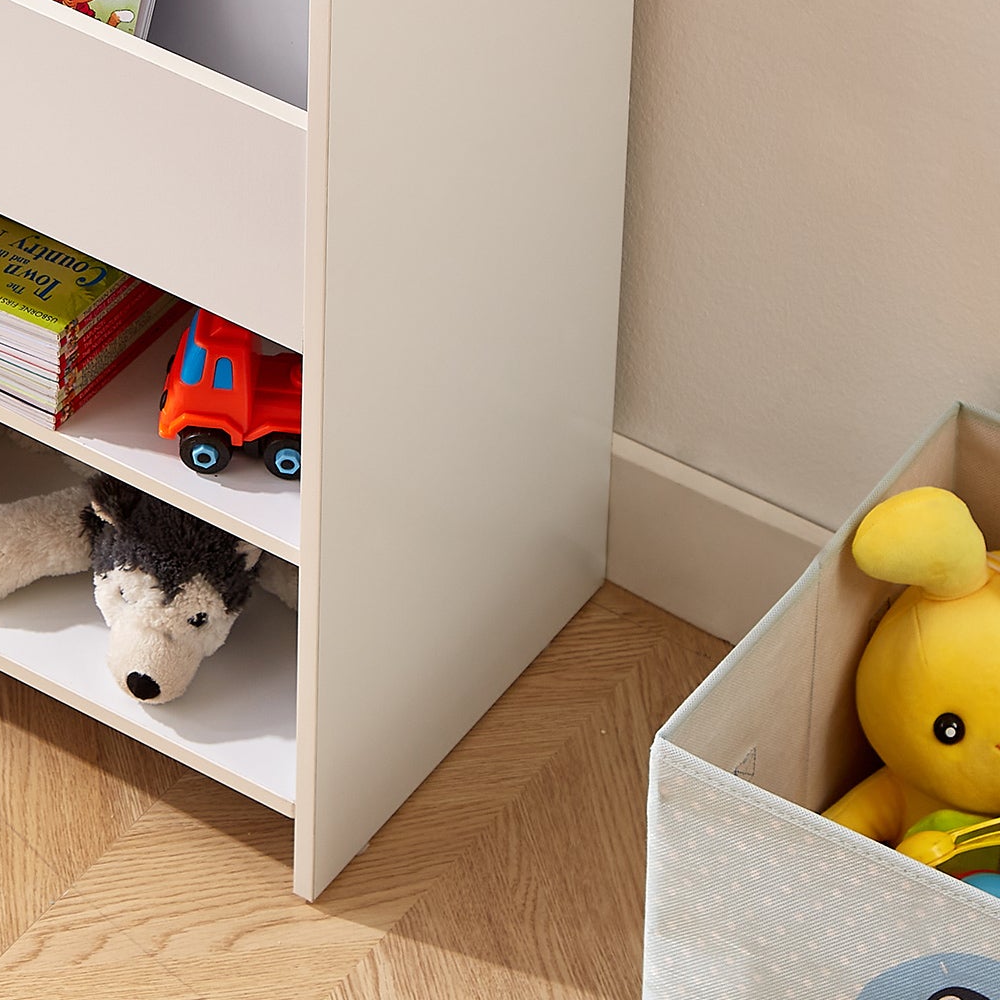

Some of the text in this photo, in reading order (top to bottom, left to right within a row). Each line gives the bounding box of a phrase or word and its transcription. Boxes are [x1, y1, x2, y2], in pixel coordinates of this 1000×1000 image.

[9, 235, 108, 288] Country
[11, 255, 31, 266] and
[3, 263, 62, 302] Town
[7, 282, 25, 296] The
[0, 296, 22, 309] FIRST
[22, 305, 59, 324] USBORNE
